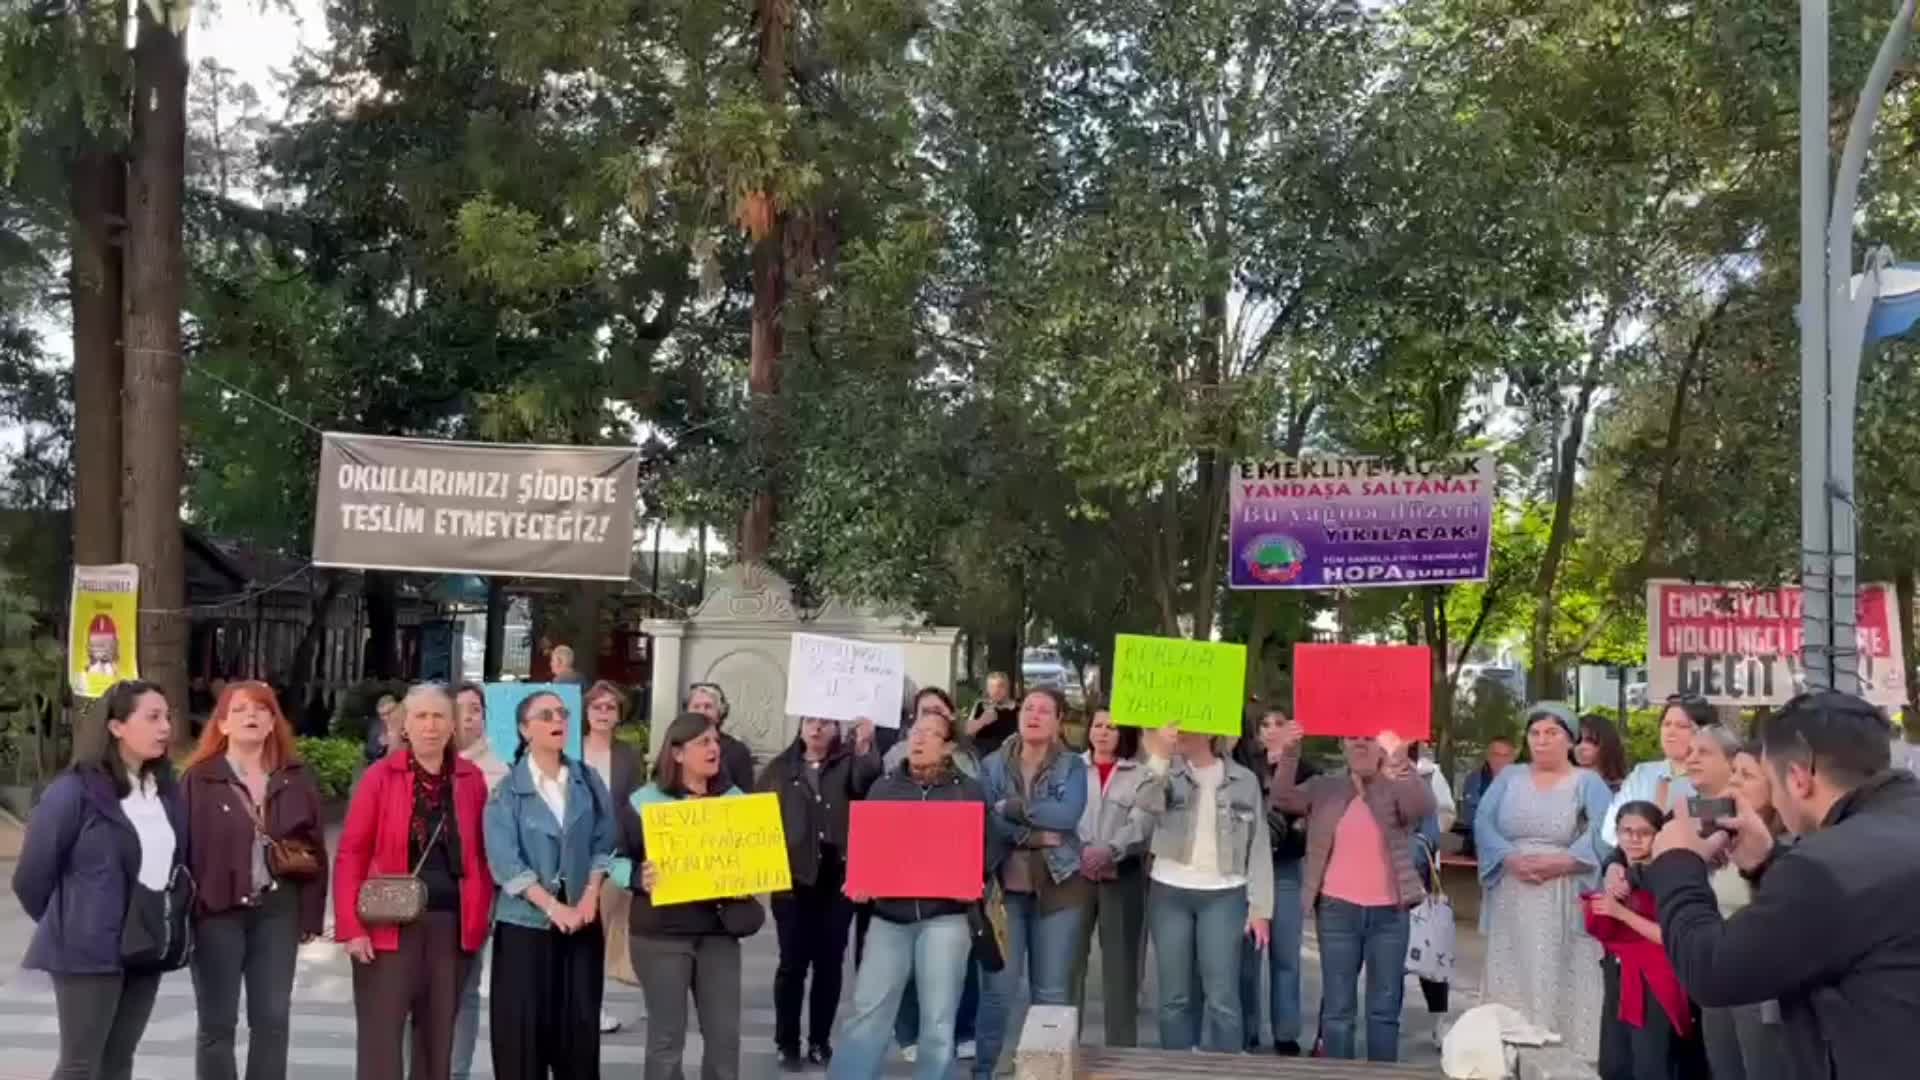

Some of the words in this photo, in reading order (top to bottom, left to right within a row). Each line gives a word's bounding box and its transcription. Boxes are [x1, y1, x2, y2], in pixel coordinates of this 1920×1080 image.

[338, 464, 509, 497] OKULLARIMIZI
[1242, 483, 1352, 500] YANDAŞA
[1361, 479, 1480, 497] SALTANAT
[339, 502, 426, 534] TESLİM
[433, 507, 611, 543] ETMEYECEĞİZ!
[1326, 524, 1478, 544] YIKILACAK!
[1323, 565, 1403, 583] HOPA
